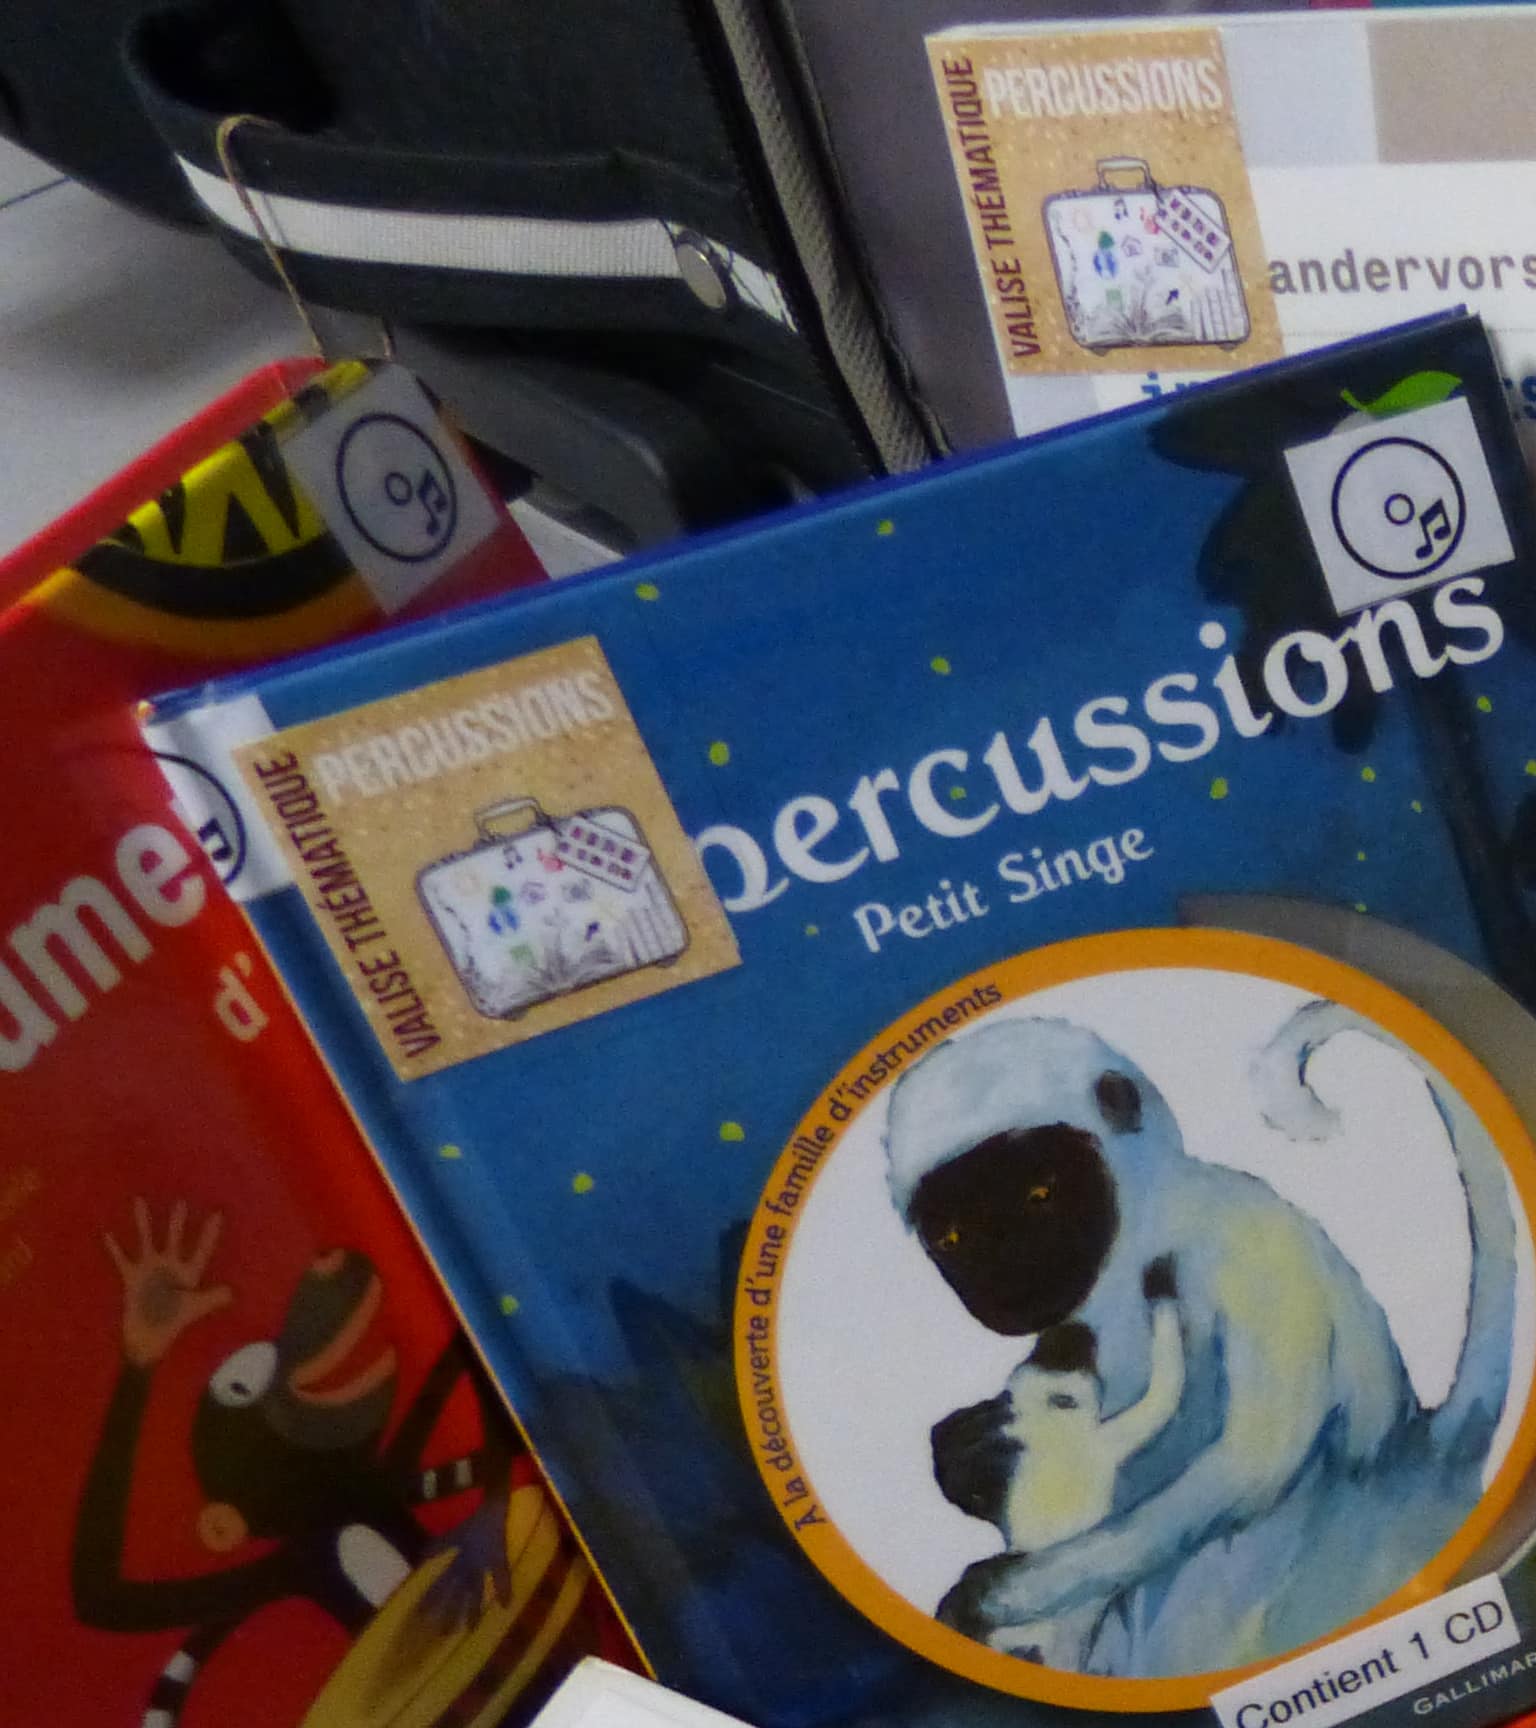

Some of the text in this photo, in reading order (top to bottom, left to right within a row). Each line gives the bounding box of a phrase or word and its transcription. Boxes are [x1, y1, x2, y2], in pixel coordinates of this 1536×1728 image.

[982, 58, 1226, 121] PERCUSSIONS
[942, 57, 1041, 359] VALISE THÉMATIQUE
[315, 669, 616, 800] PERCUSSIONS
[694, 574, 1505, 914] percussions
[254, 750, 441, 1059] VALISE THÉMATIQUE
[852, 827, 1155, 952] Petit Singe
[826, 980, 1003, 1122] d'instruments
[764, 1124, 836, 1218] famille
[743, 1223, 785, 1307] d'une
[745, 1311, 796, 1473] découverte
[783, 1475, 810, 1508] la
[1409, 1632, 1430, 1660] 1
[1444, 1600, 1503, 1645] CD
